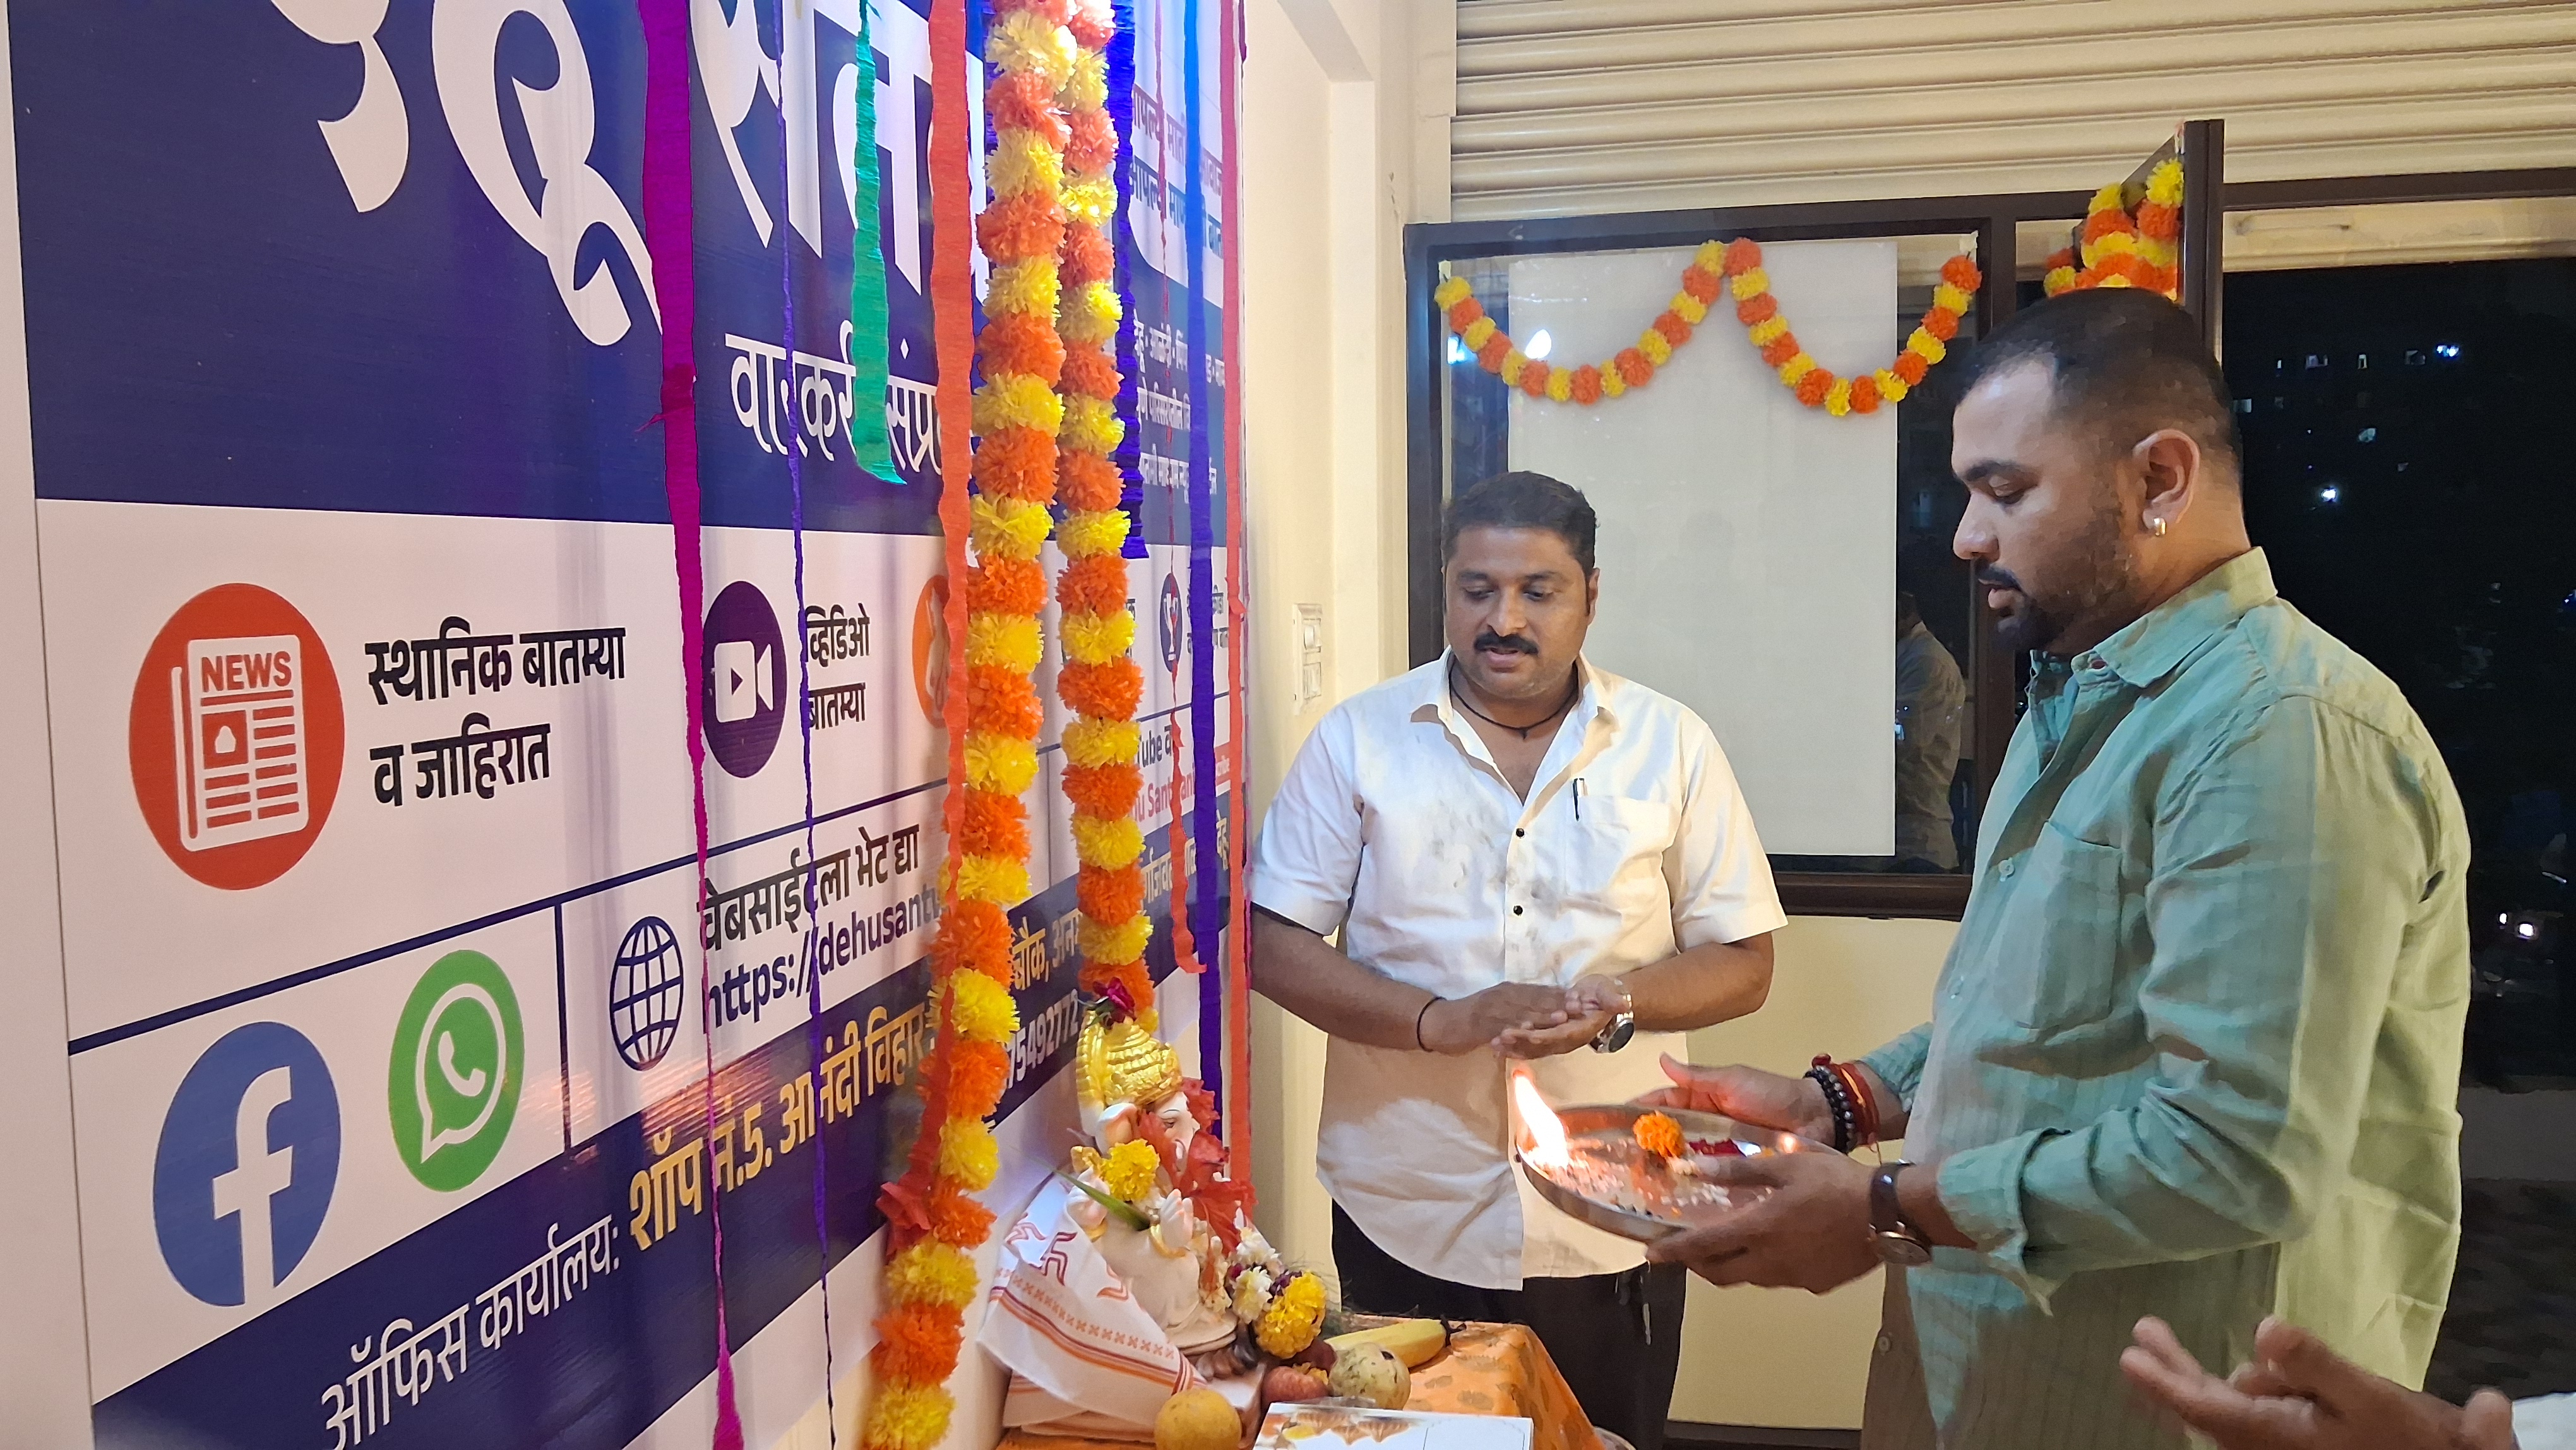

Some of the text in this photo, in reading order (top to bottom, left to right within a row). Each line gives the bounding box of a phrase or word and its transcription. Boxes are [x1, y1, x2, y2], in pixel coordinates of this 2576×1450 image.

[201, 650, 292, 692] NEWS
[364, 615, 626, 706] स्थानिक बातम्या
[369, 712, 551, 807] व जाहिरात
[855, 826, 890, 888] भेट
[892, 824, 920, 876] द्या
[321, 1317, 470, 1450] ऑफिस
